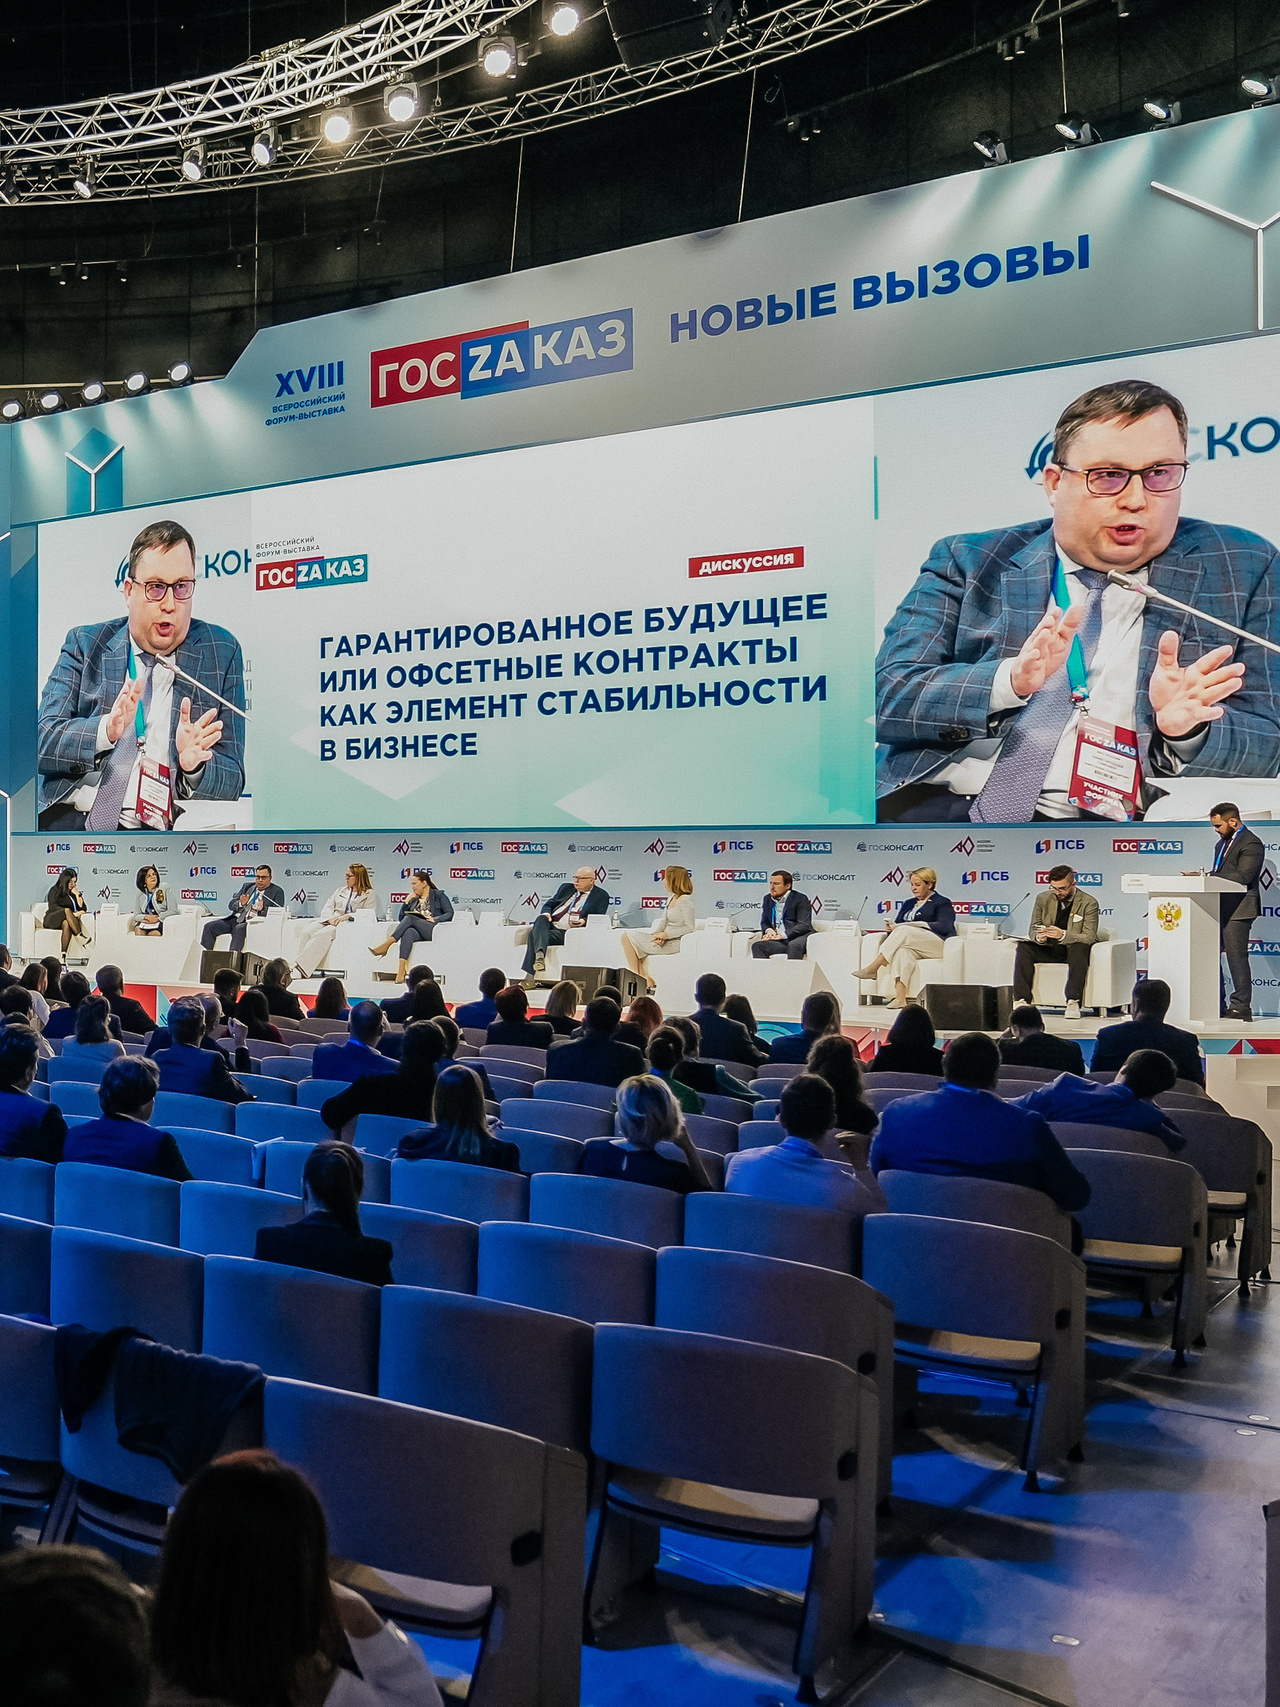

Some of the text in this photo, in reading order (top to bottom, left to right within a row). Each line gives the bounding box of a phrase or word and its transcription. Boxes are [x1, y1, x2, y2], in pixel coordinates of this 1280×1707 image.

[669, 234, 1091, 344] НОВЫЕ ВЫЗОВЫ
[274, 360, 344, 398] XVIII
[272, 391, 346, 414] ВСЕРОССИЙСКИЙ
[264, 405, 346, 427] ФОРУМ-ВЫСТАВКА
[255, 536, 315, 550] ВСЕРОССИЙСКИЙ
[319, 592, 828, 659] ГАРАНТИРОВАННОЕ БУДУЩЕЕ
[319, 636, 798, 693] ИЛИ ОФСЕТНЫЕ КОНТРАКТЫ
[319, 675, 828, 727] КАК ЭЛЕМЕНТ СТАБИЛЬНОСТИ
[320, 732, 478, 761] В БИЗНЕСЕ
[55, 843, 71, 852] ПСБ
[241, 843, 259, 852] ПСБ
[462, 842, 484, 851] ПСБ
[729, 841, 754, 850] ПСБ
[868, 844, 925, 852] ГОСКОНСАЛТ
[1055, 840, 1085, 850] ПСБ
[200, 866, 217, 875] ПСБ
[981, 871, 1009, 881] ПСБ
